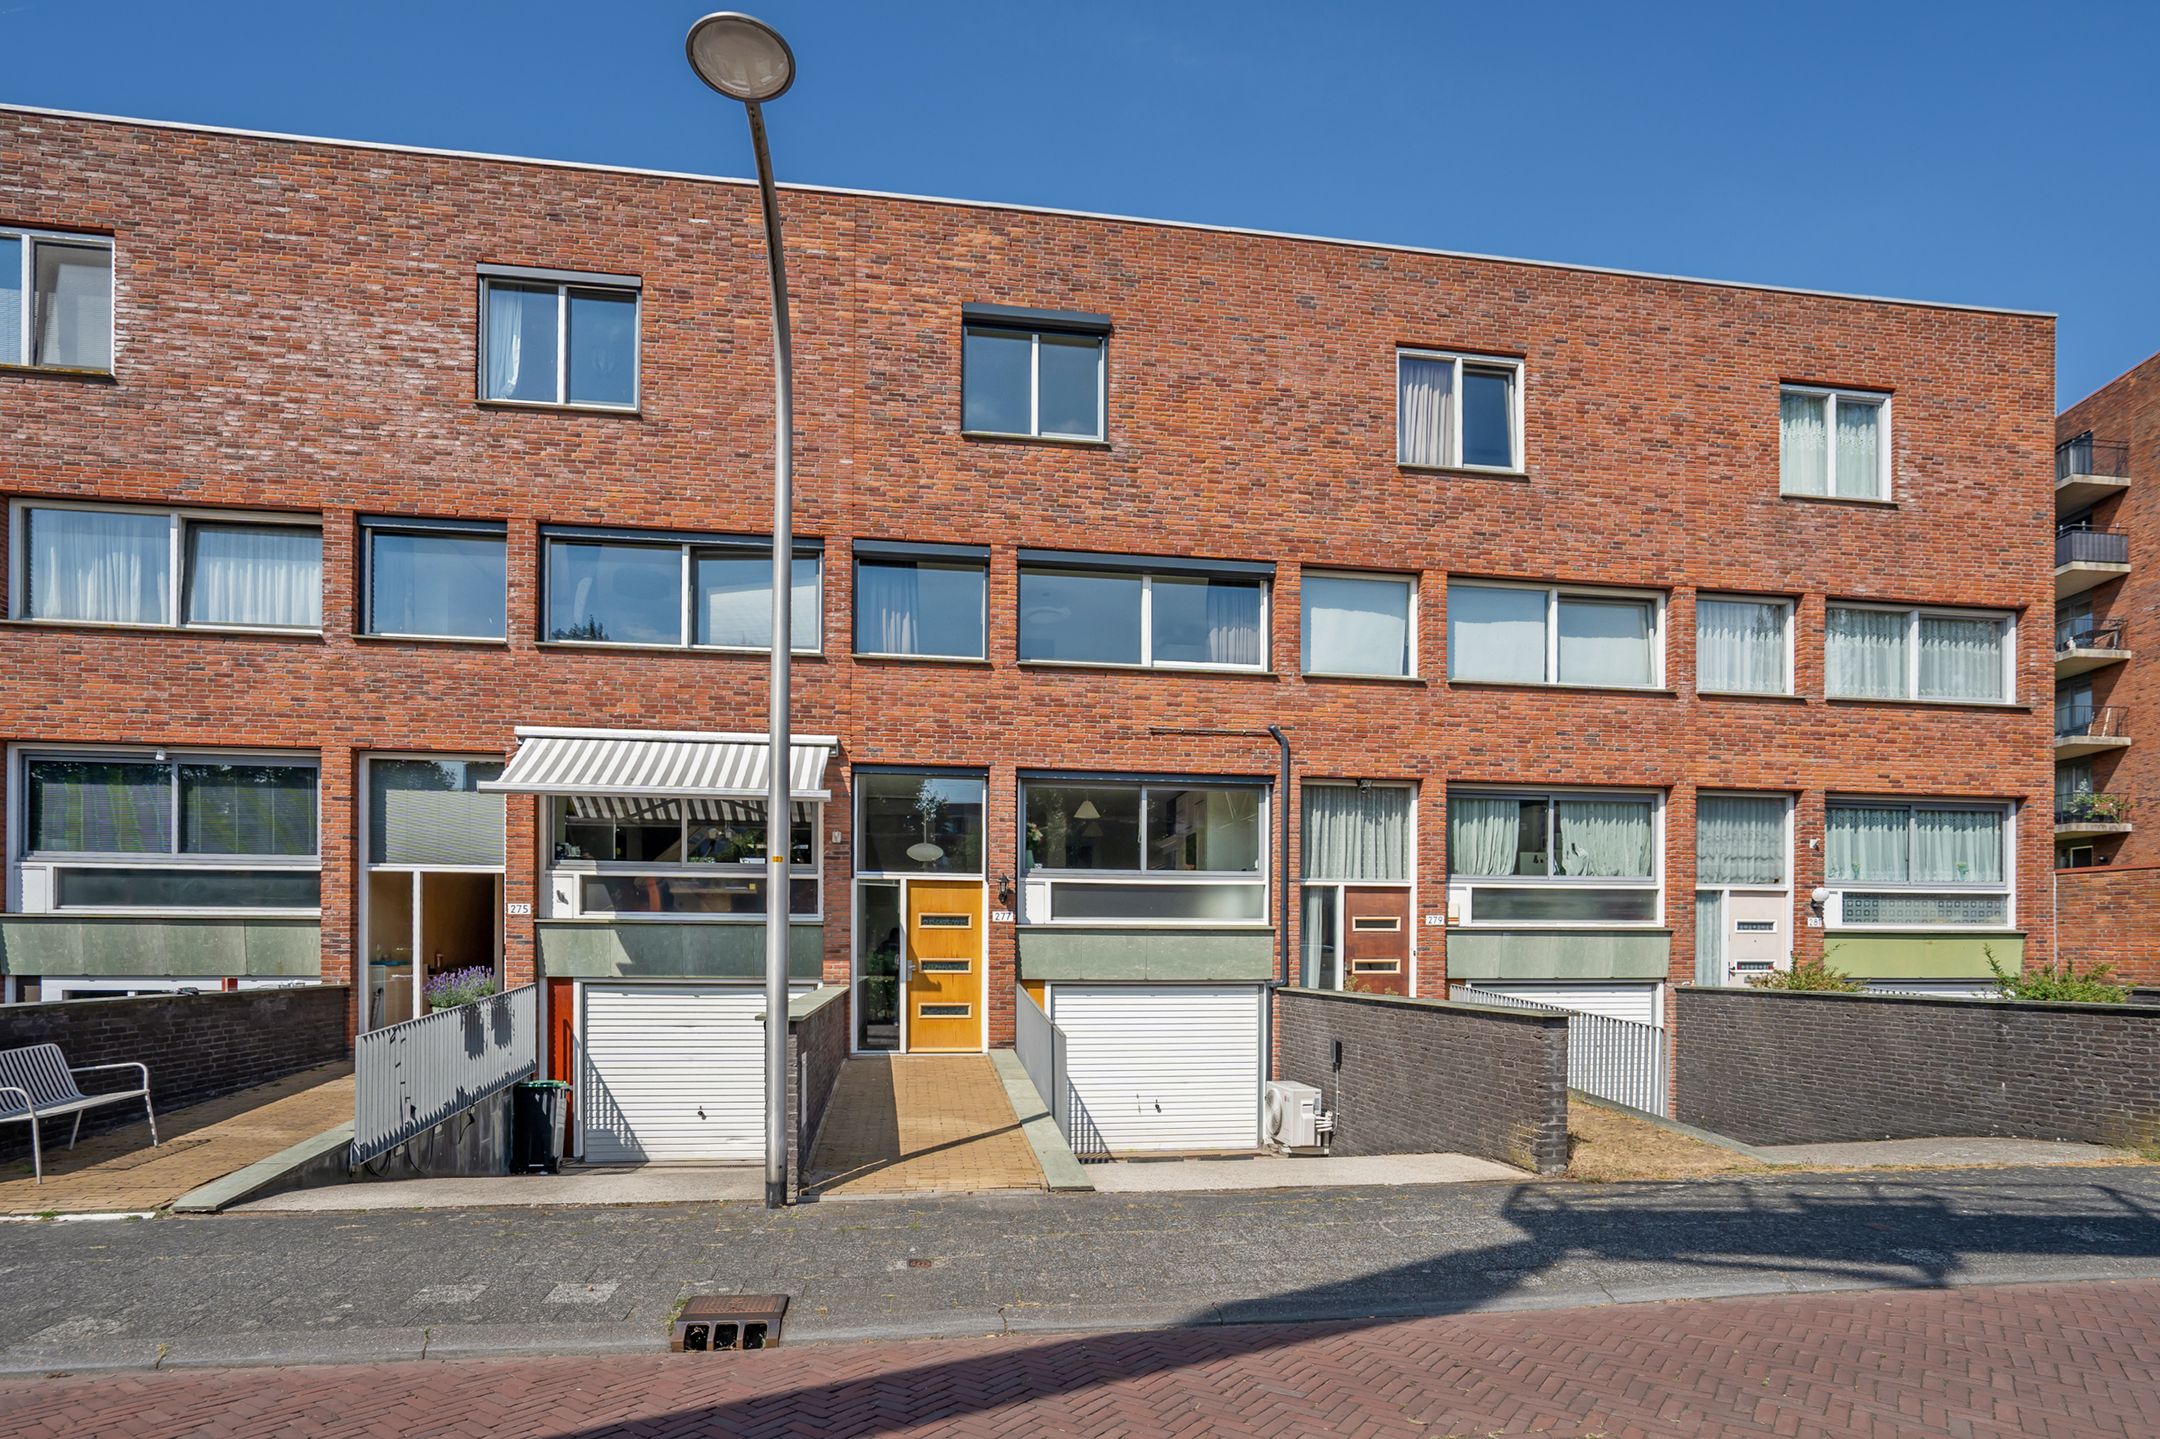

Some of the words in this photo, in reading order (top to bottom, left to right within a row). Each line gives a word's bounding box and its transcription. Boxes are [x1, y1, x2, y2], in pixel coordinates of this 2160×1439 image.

[510, 904, 529, 914] 275
[995, 912, 1011, 921] 277
[1428, 916, 1443, 925] 279
